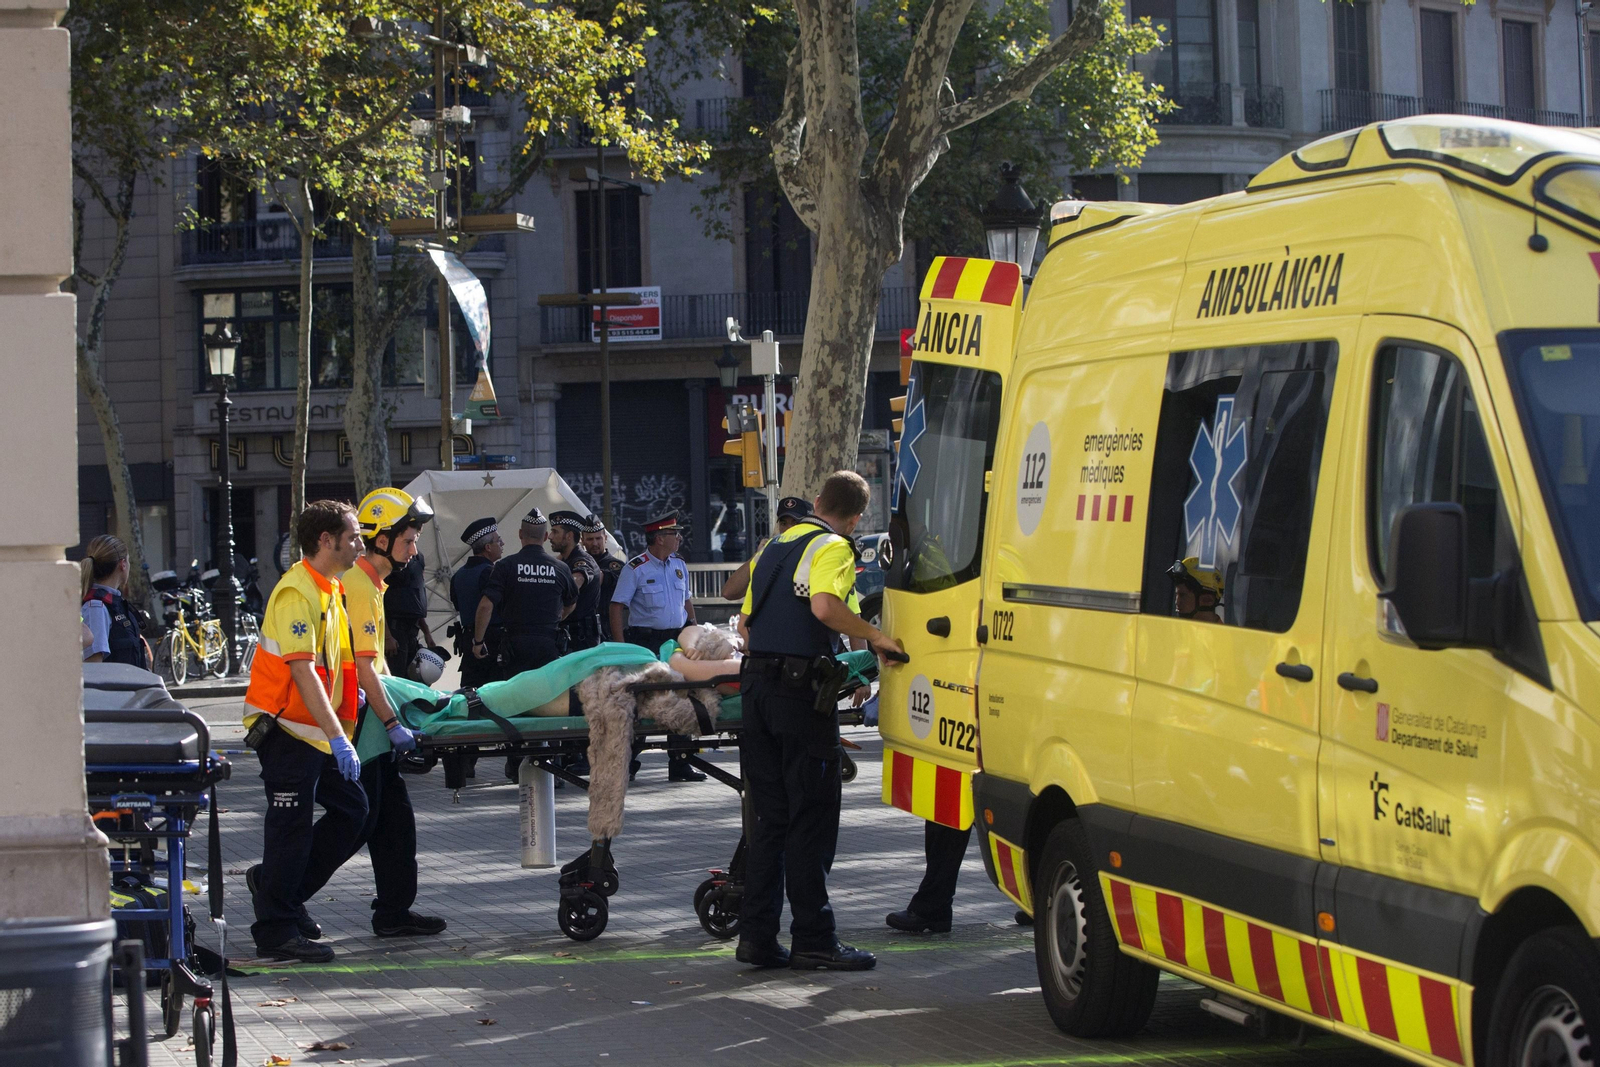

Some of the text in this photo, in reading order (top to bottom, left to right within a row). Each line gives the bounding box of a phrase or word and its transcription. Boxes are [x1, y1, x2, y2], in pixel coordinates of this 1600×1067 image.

[1196, 245, 1345, 319] AMBULÀNCIA
[609, 314, 644, 322] Disponible
[1084, 427, 1143, 458] emergències
[1022, 452, 1046, 489] 112
[1080, 459, 1125, 489] mèdiques
[517, 563, 556, 577] POLICIA
[993, 610, 1014, 641] 0722
[911, 690, 930, 715] 112
[933, 679, 975, 696] BLUETEC
[939, 717, 976, 753] 0722
[1391, 707, 1487, 742] Generalitat de Catalunya
[1391, 728, 1478, 759] Departament de Salut
[1395, 802, 1451, 837] CatSalut
